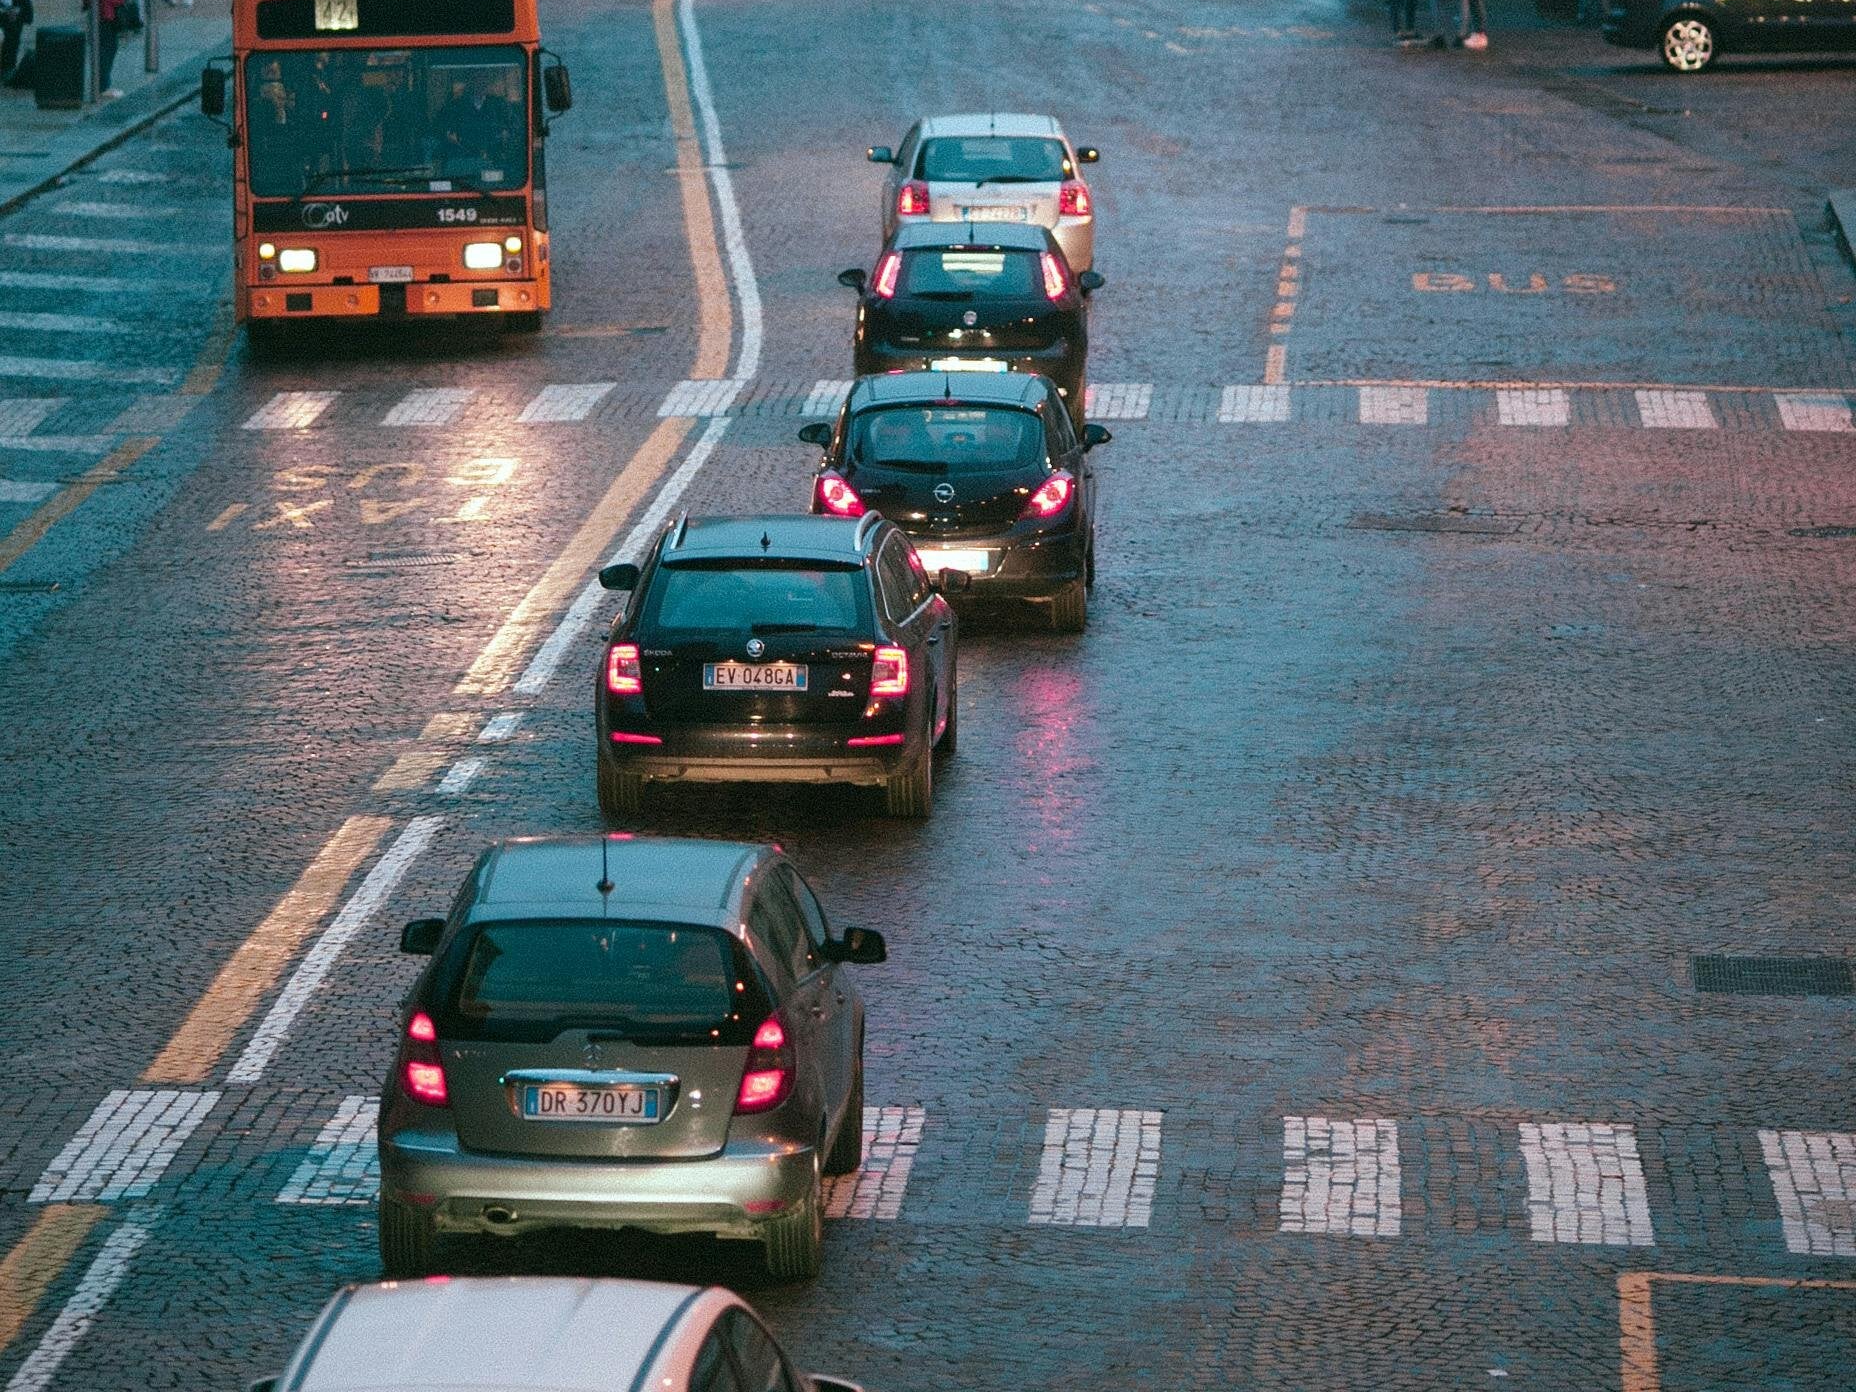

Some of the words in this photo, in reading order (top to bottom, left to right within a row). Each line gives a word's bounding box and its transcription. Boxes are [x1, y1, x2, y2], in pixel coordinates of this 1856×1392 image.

[437, 208, 478, 222] 1549
[1411, 272, 1617, 294] BUS
[205, 495, 494, 531] TAXI
[716, 667, 736, 684] EV
[541, 1091, 566, 1113] DR
[576, 1091, 644, 1115] 370YJ
